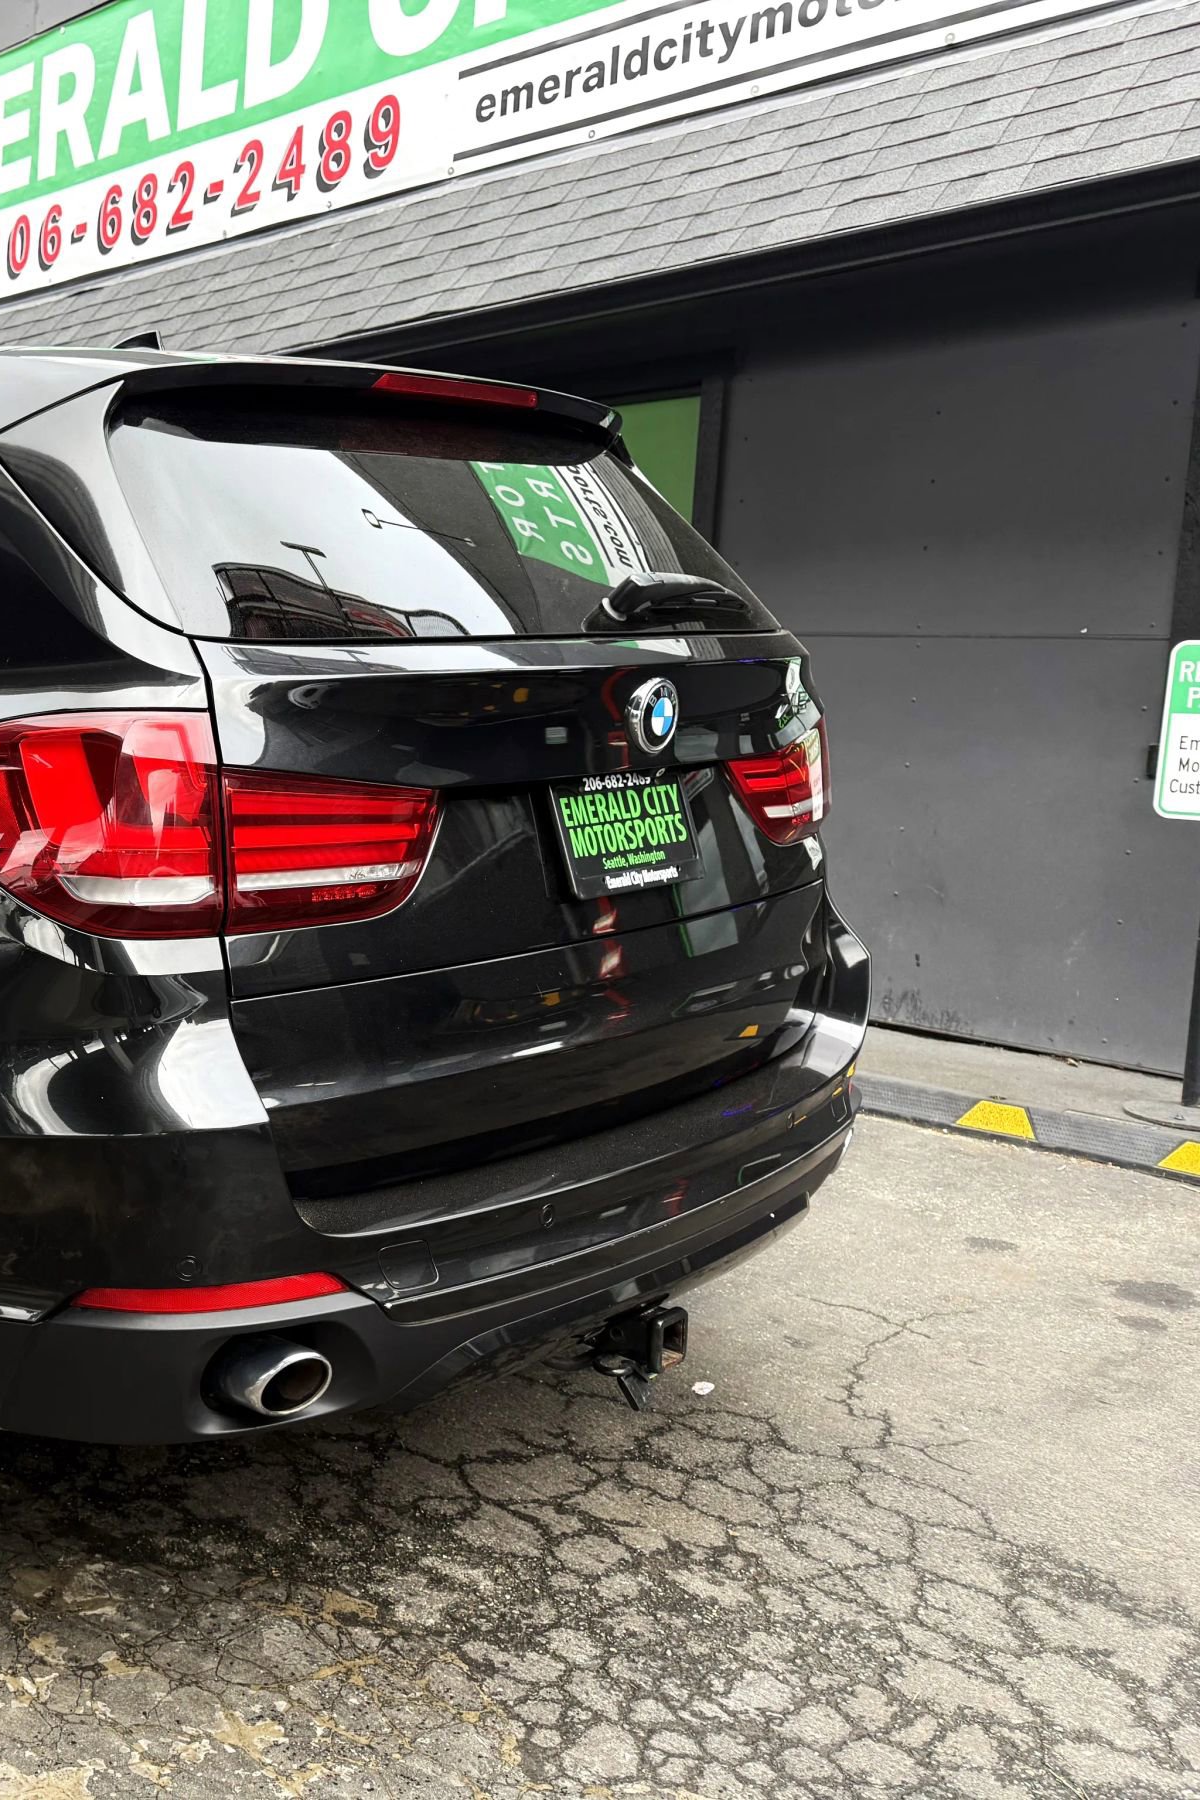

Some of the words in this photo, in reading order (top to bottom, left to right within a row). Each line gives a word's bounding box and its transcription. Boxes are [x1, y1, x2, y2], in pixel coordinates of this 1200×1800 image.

[475, 0, 904, 123] emeraldcitymo
[648, 686, 677, 707] BMW
[559, 789, 642, 828] EMERALD
[643, 783, 680, 816] CITY
[569, 813, 688, 859] MOTORSPORTS
[602, 854, 629, 870] Seattle,
[627, 849, 666, 865] Washington
[605, 872, 632, 889] Emerald
[630, 870, 644, 887] City
[641, 865, 679, 883] Motorsports
